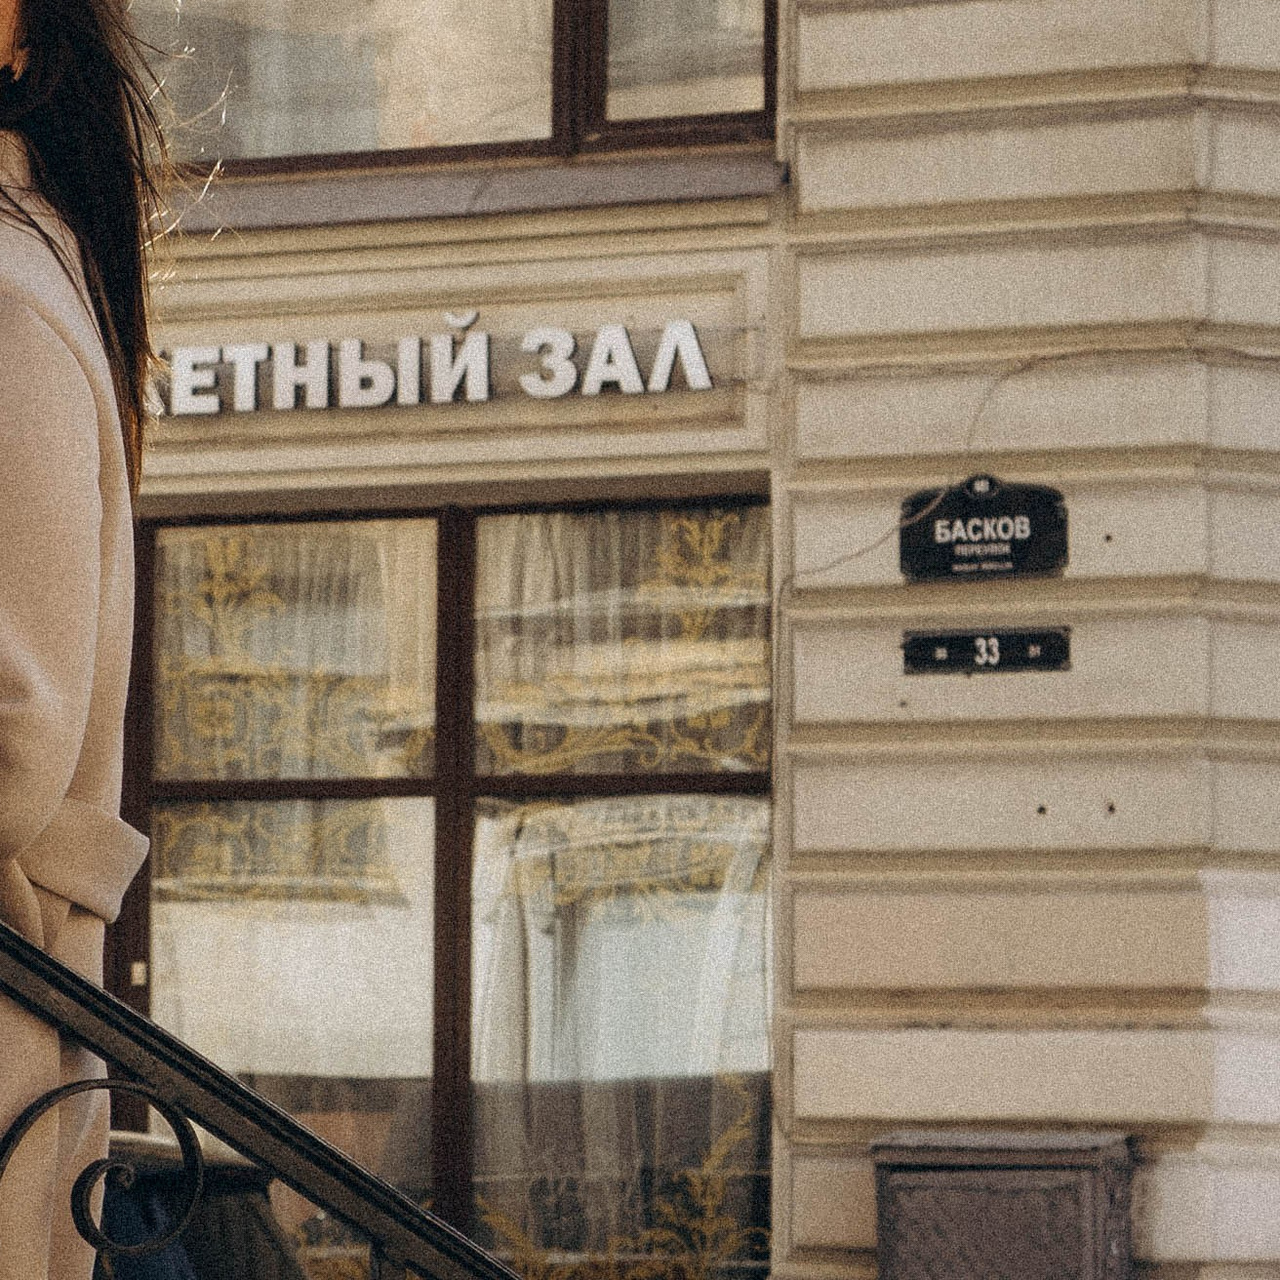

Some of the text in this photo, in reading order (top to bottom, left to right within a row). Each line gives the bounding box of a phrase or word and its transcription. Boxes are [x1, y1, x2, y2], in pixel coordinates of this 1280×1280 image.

[146, 310, 713, 416] ЕТНЫЙ ЗАЛ
[934, 515, 1031, 544] БАСКОВ
[974, 637, 1000, 666] 33
